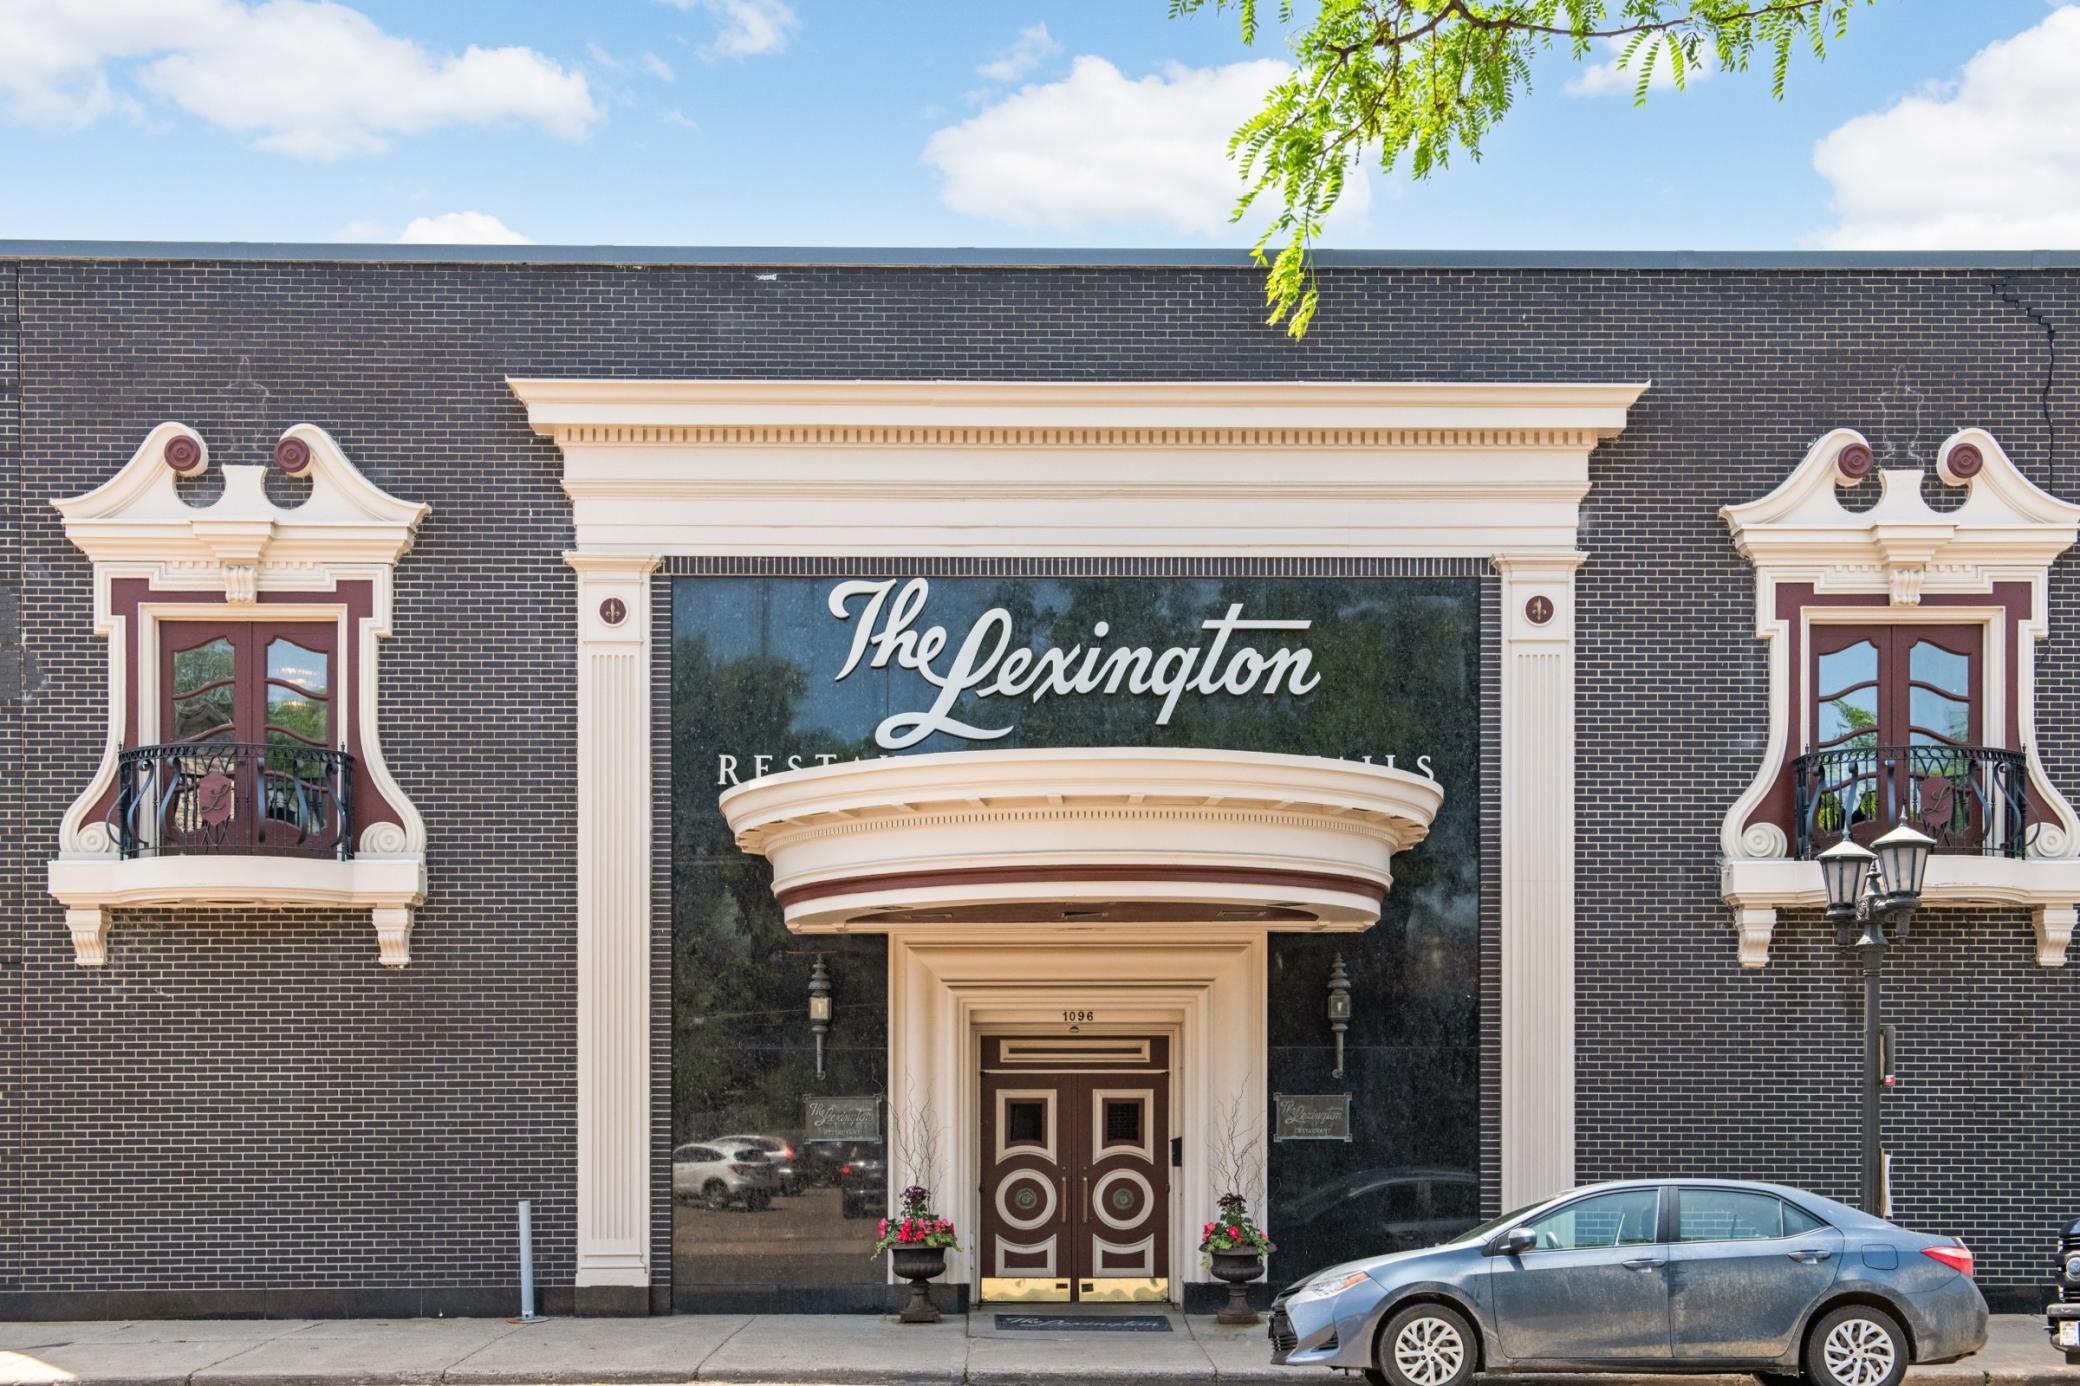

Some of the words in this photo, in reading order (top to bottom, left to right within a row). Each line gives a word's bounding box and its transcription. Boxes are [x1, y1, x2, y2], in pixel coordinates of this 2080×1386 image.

[828, 577, 947, 682] The
[874, 603, 1322, 750] Lexington
[1063, 1010, 1094, 1022] 1096
